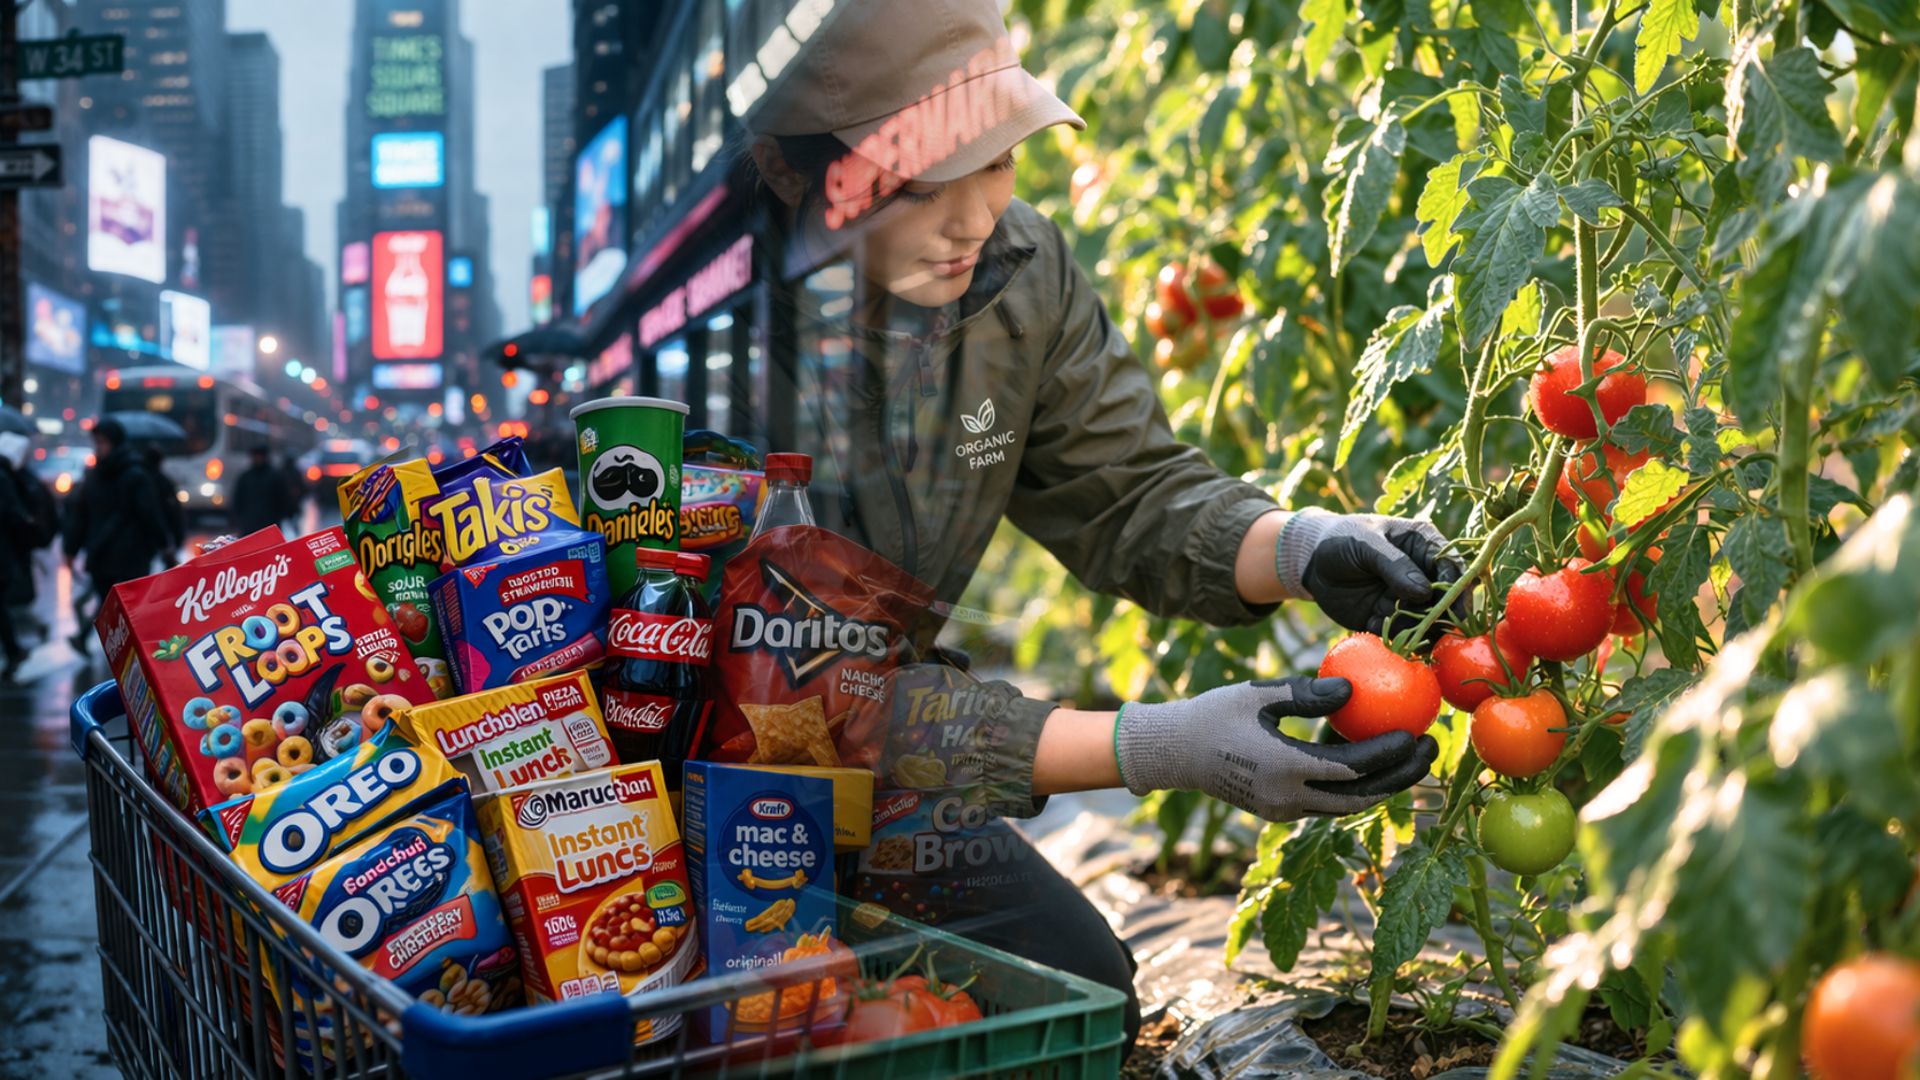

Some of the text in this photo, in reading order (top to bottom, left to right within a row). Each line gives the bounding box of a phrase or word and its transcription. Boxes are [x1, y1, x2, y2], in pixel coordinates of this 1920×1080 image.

[25, 39, 118, 75] W 34 ST
[955, 430, 1016, 458] ORGANIC
[969, 450, 1006, 470] FARM
[428, 477, 550, 562] Takis
[187, 582, 329, 690] FROOT
[732, 608, 889, 657] Doritos
[232, 616, 351, 705] LOOPS
[479, 727, 554, 770] Instant
[263, 750, 419, 868] OREO
[758, 803, 787, 816] Kraft
[548, 814, 645, 858] Instant
[728, 843, 816, 868] cheese
[736, 825, 787, 844] mac
[791, 823, 809, 845] &
